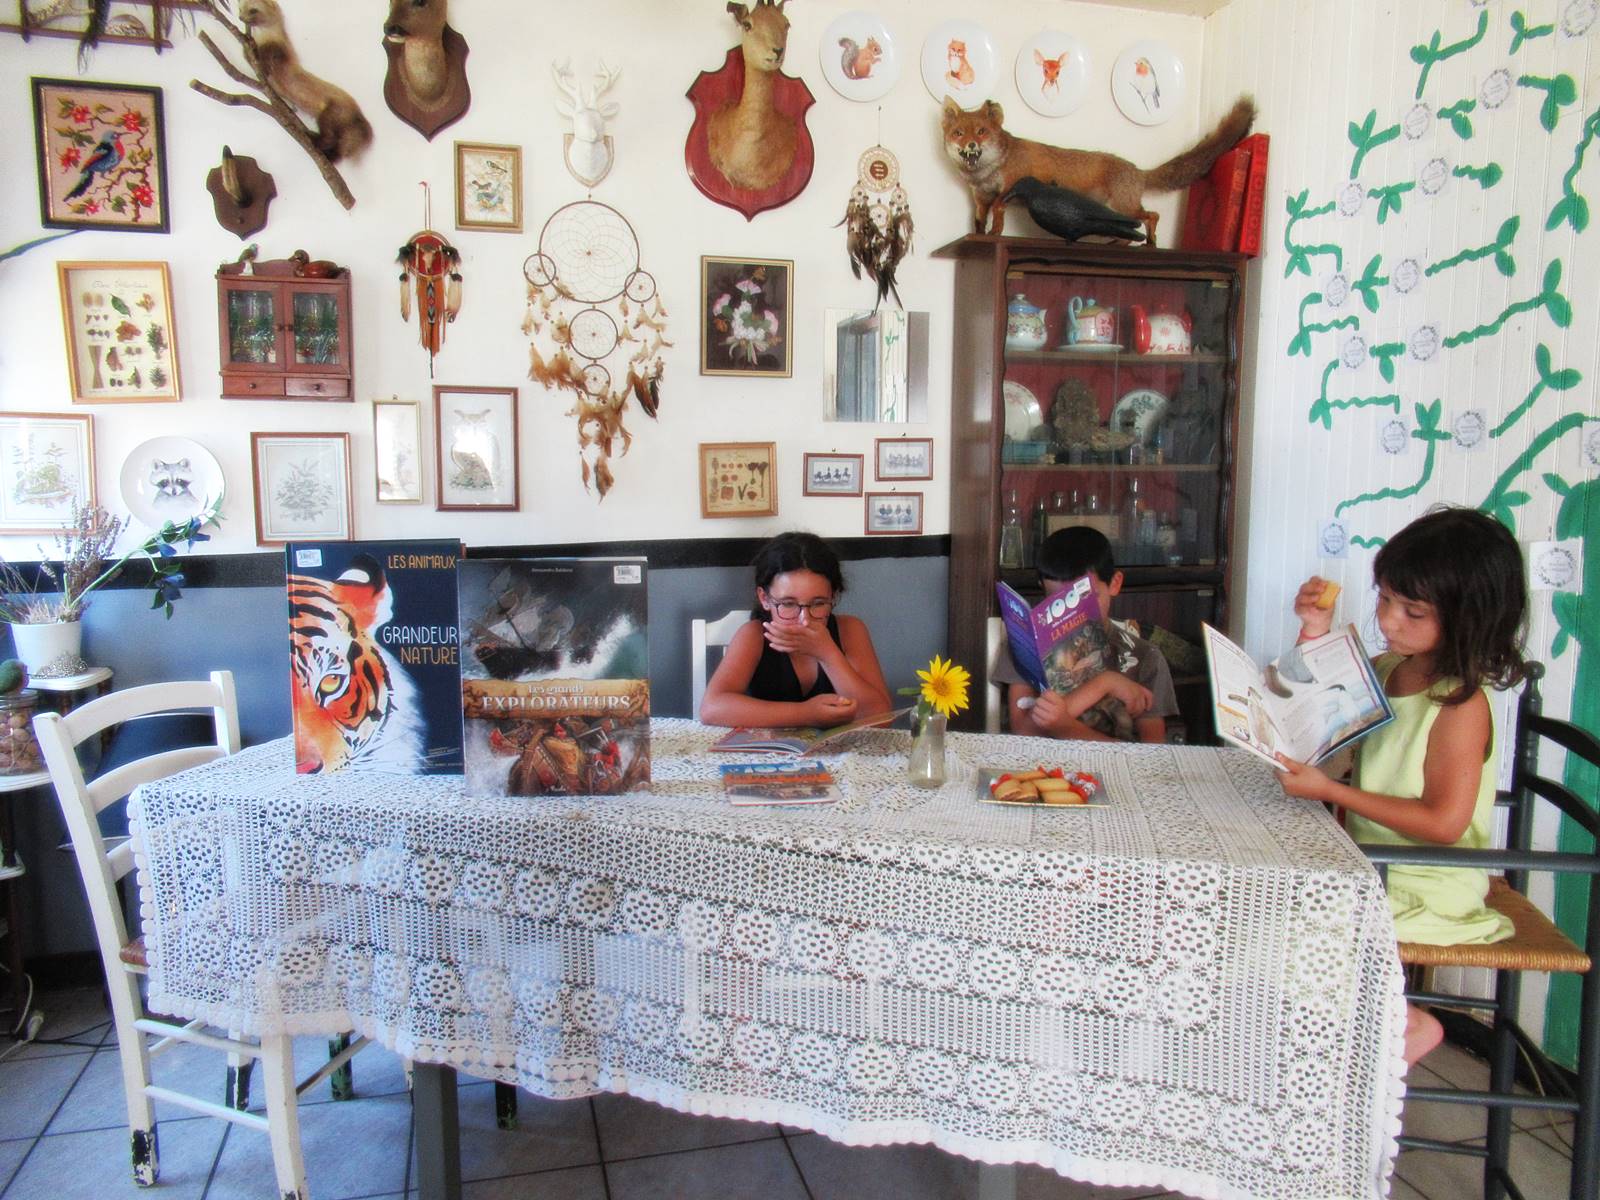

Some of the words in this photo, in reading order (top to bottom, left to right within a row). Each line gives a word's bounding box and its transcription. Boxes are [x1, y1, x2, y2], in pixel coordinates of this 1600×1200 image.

[388, 555, 406, 569] LES
[408, 555, 456, 569] ANIMAUX
[1045, 590, 1080, 625] 100
[382, 625, 458, 644] GRANDEUR
[400, 646, 459, 665] NATURE
[482, 695, 631, 710] EXPLORATEURS
